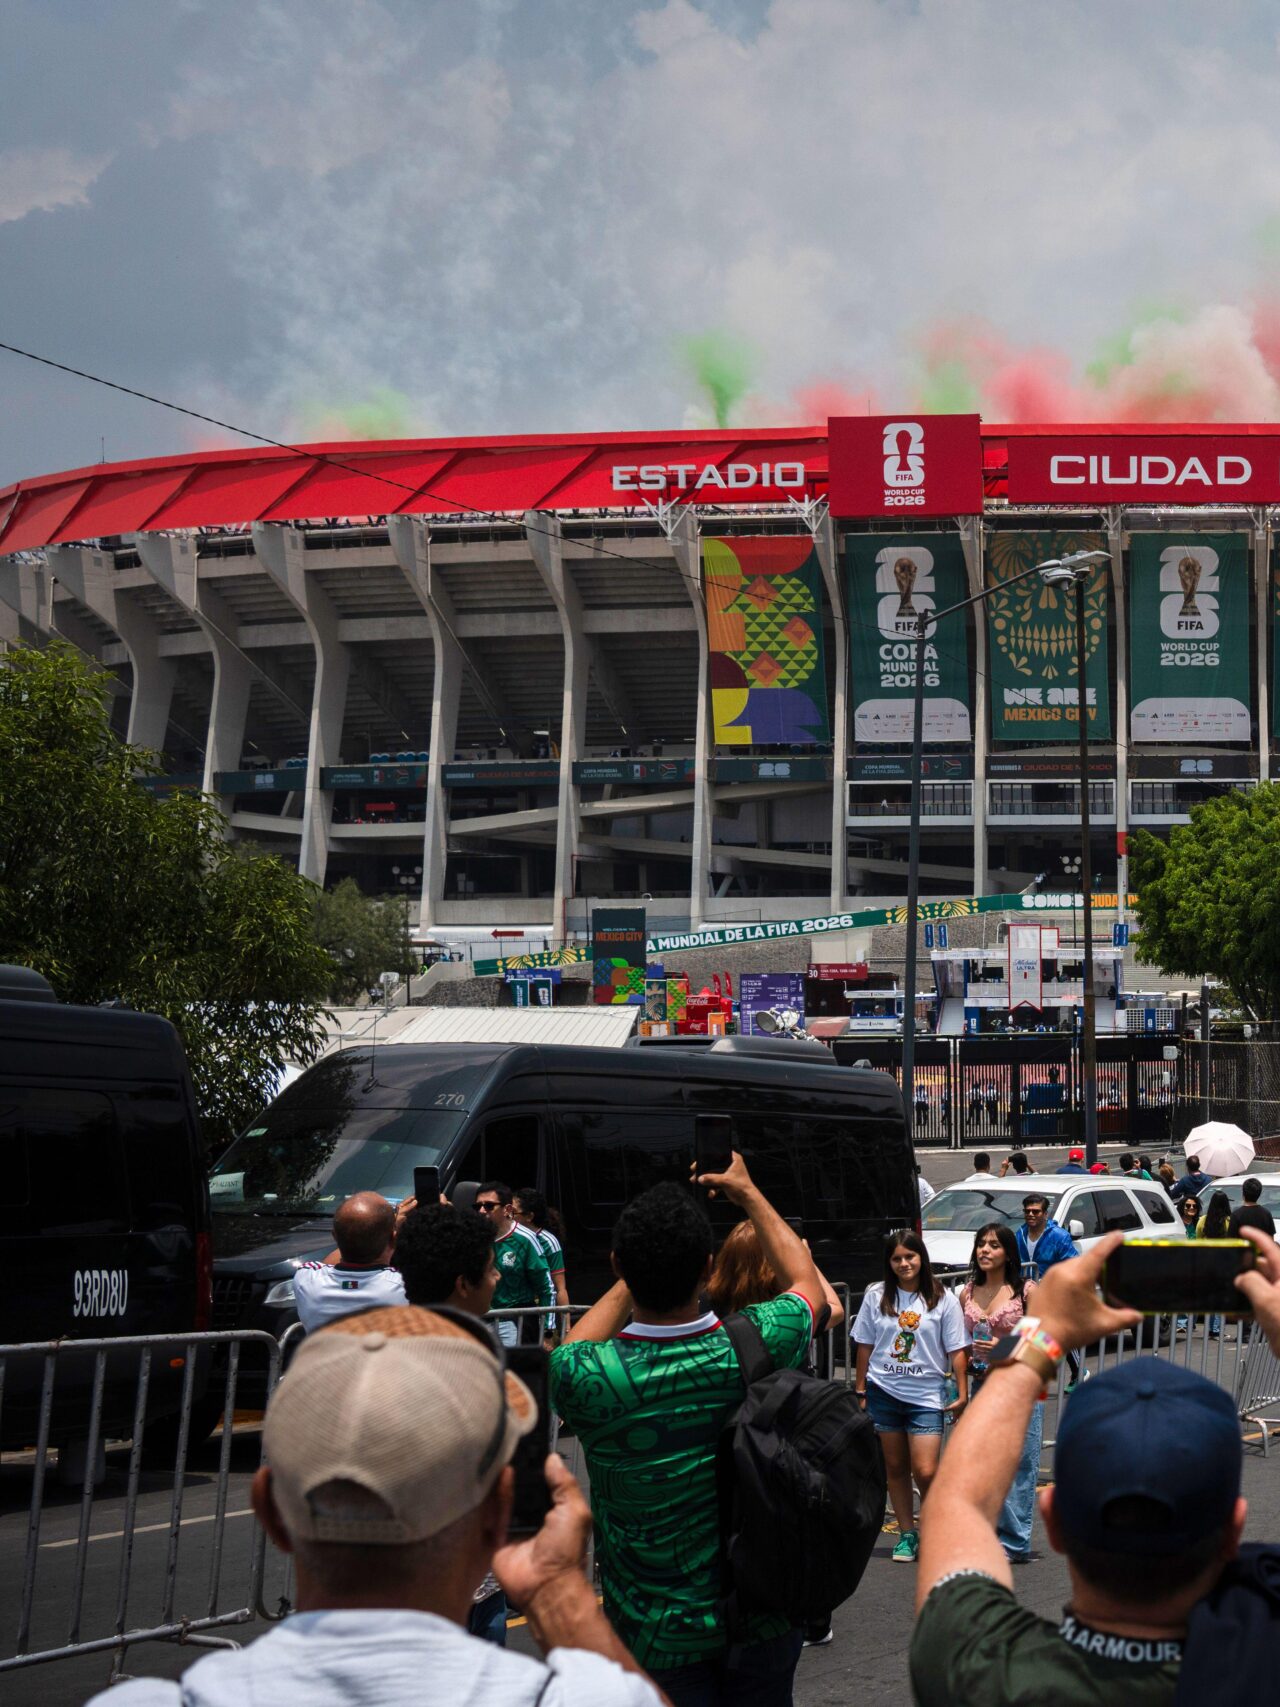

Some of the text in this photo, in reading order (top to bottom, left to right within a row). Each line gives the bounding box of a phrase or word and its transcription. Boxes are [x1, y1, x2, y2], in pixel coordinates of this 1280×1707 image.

[612, 462, 805, 490] ESTADIO
[1050, 455, 1252, 485] CIUDAD
[884, 496, 926, 506] 2026
[1177, 621, 1204, 630] FIFA
[1161, 643, 1220, 651] WORLD CUP
[1160, 653, 1220, 666] 2026
[880, 662, 940, 672] MUNDAL
[1003, 688, 1043, 705] WE
[1004, 708, 1097, 721] MEXICO CIY
[1022, 894, 1084, 908] SOMOS
[596, 931, 643, 941] MEXICO CITY
[658, 933, 722, 950] MUNDIAL
[725, 928, 743, 942] DE
[746, 926, 766, 940] LA
[767, 922, 799, 938] FIFA
[801, 915, 854, 932] 2026
[808, 969, 818, 978] 30
[434, 1094, 465, 1105] 270
[73, 1269, 128, 1317] 93RD8U
[883, 1364, 923, 1375] SABINA
